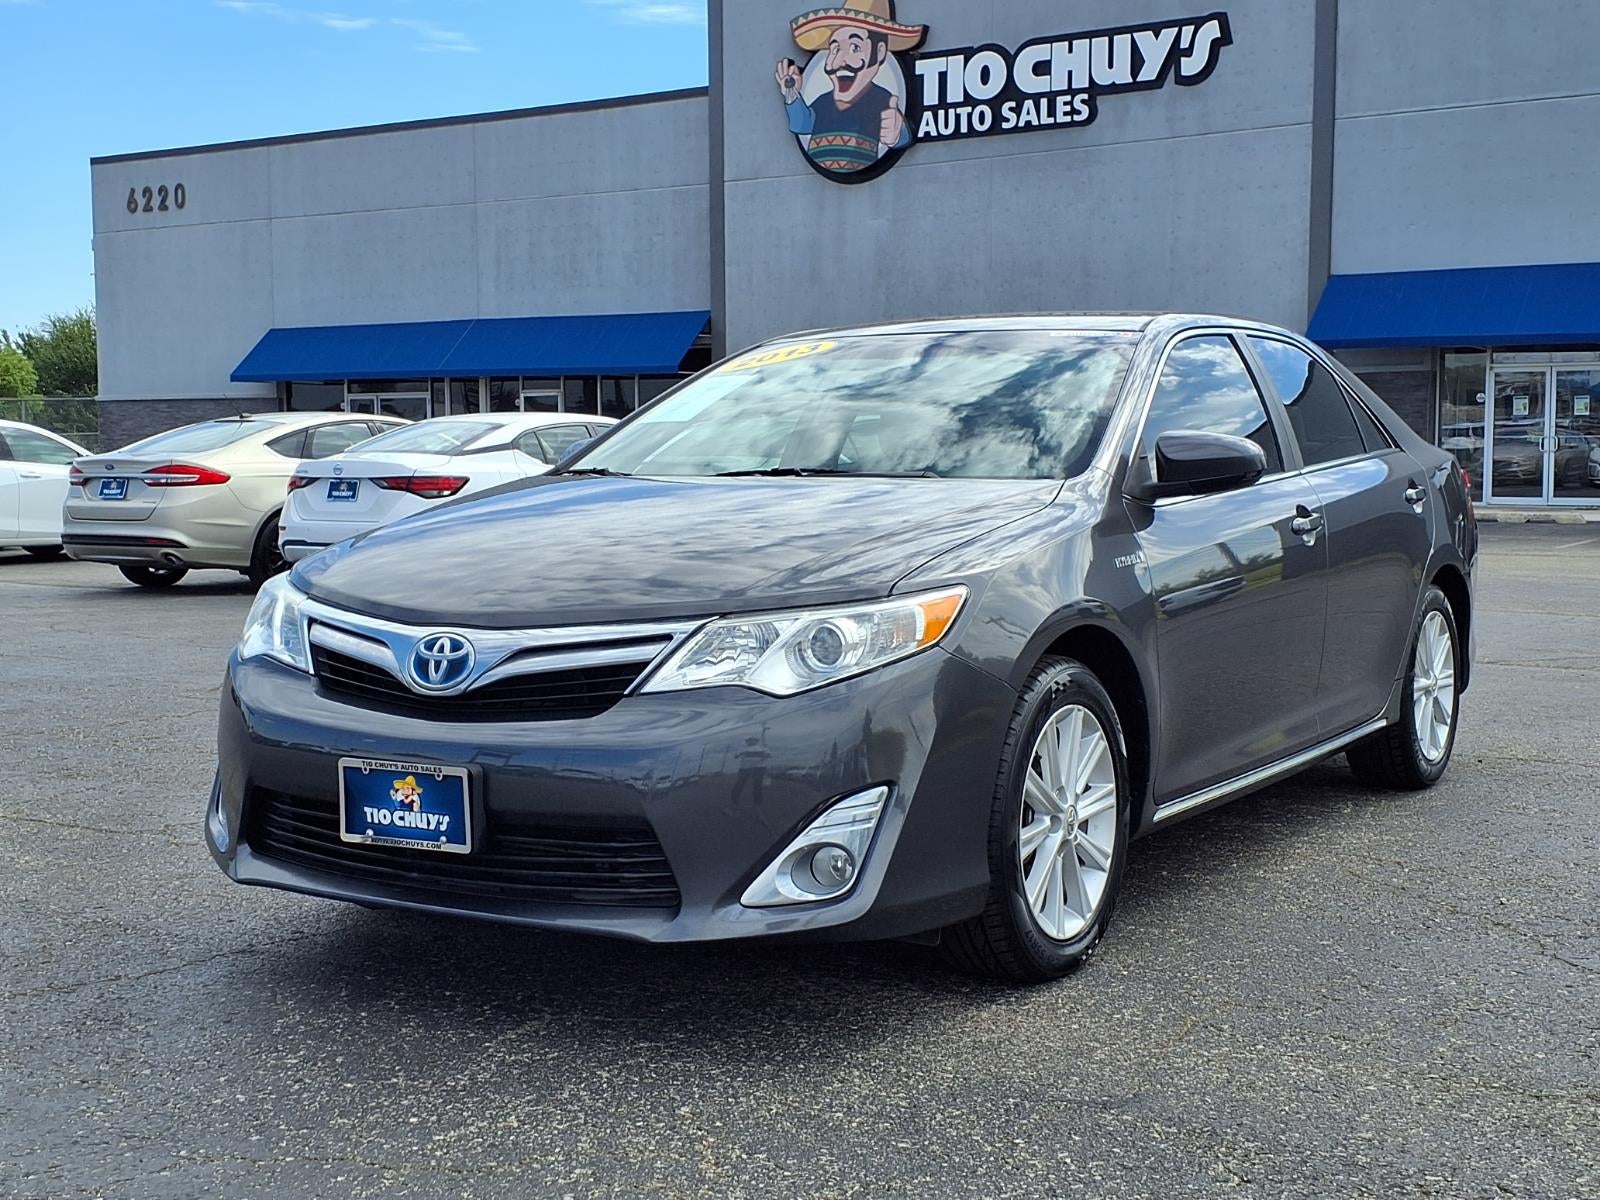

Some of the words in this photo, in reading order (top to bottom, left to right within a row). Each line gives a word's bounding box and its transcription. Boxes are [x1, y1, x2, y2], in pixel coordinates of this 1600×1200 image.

[915, 50, 1007, 106] TIO
[1013, 19, 1221, 93] CHUY'S
[917, 105, 992, 138] AUTO
[1001, 93, 1090, 129] SALES
[127, 183, 186, 214] 6220
[362, 760, 373, 769] TIO
[374, 761, 399, 770] CHUY'S
[400, 763, 419, 772] AUTO
[420, 765, 443, 774] SALES
[364, 806, 391, 825] TIO
[392, 810, 450, 832] CHUY'S
